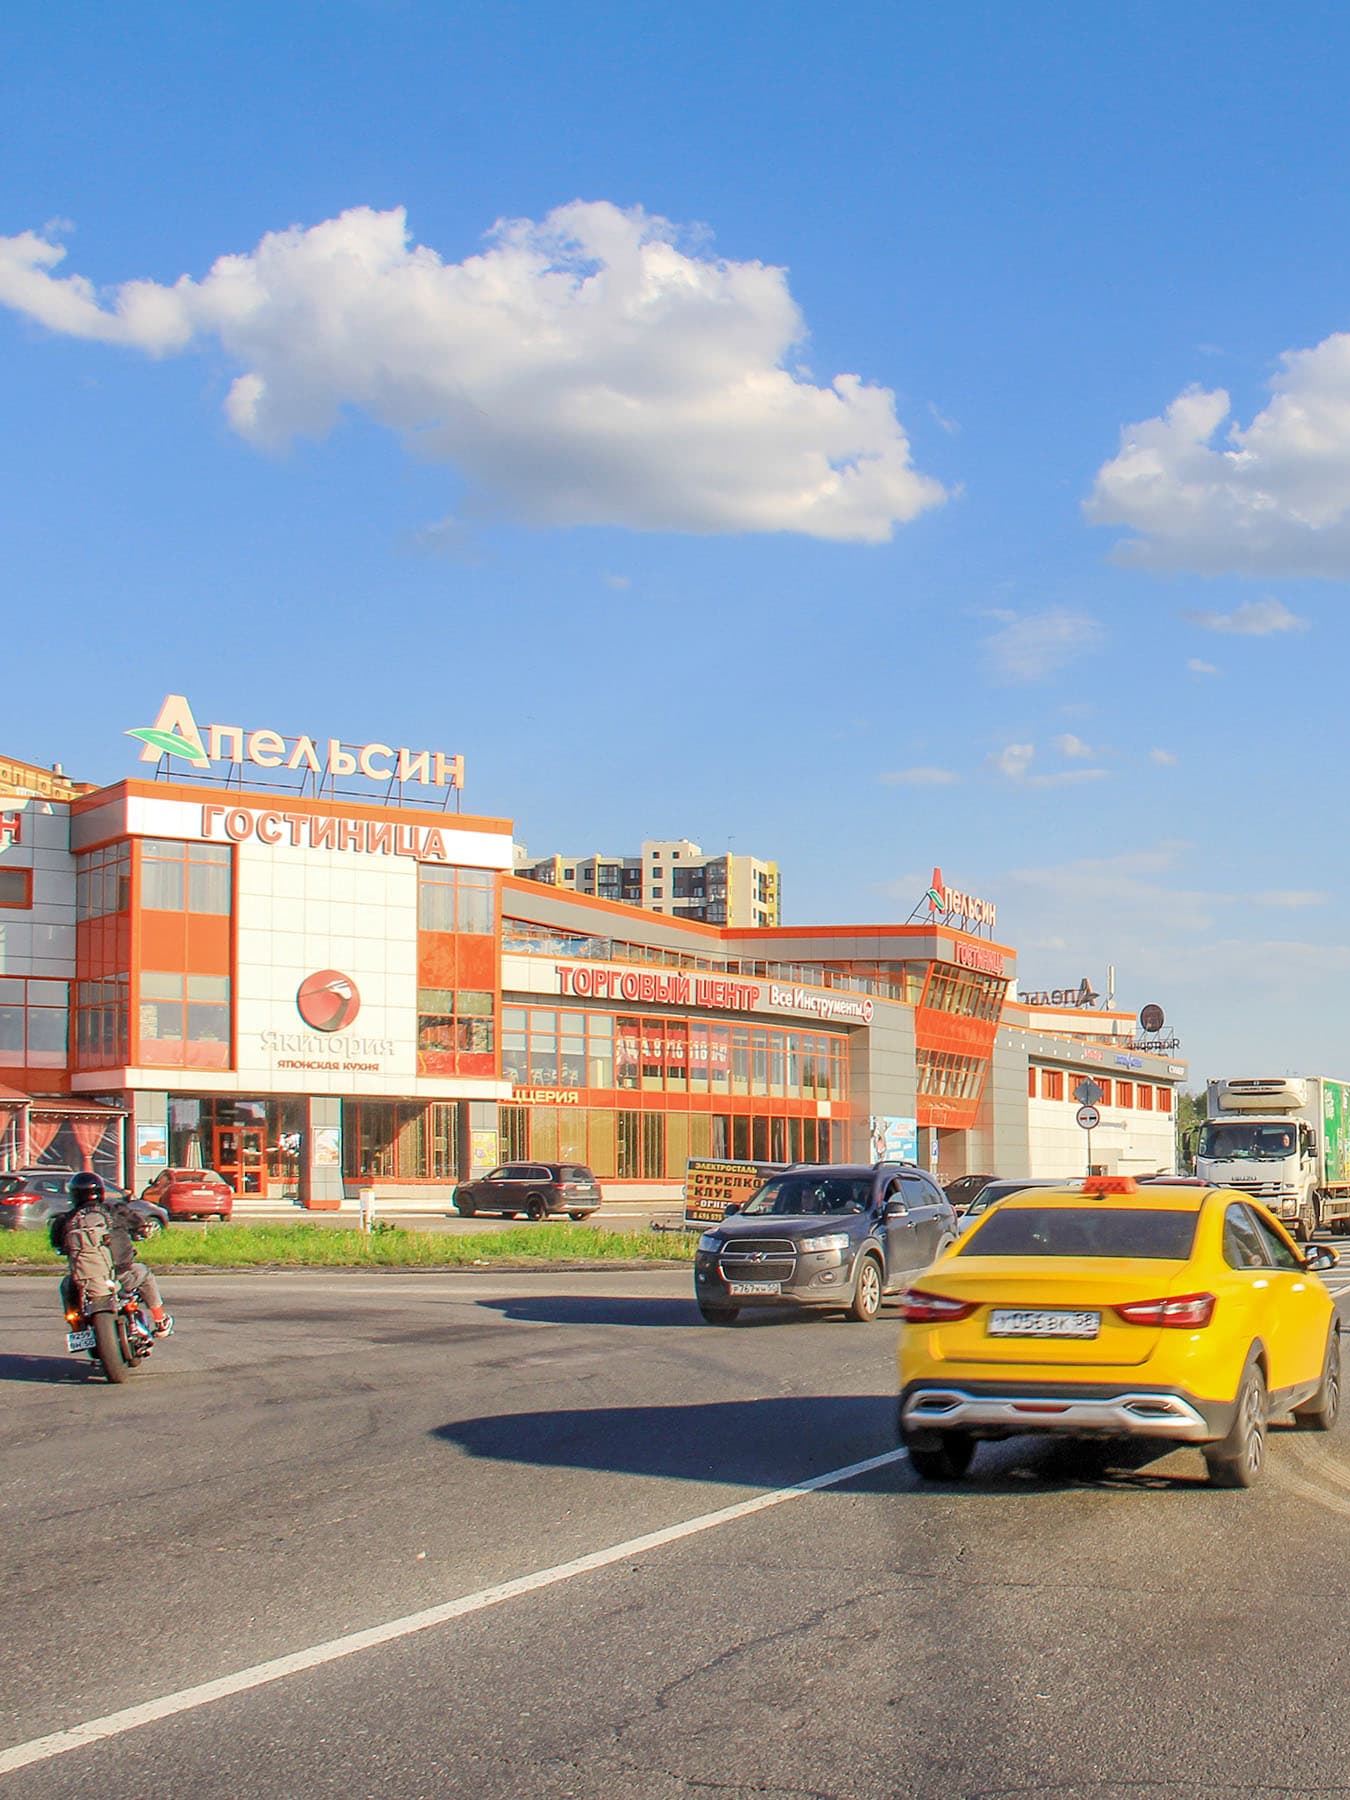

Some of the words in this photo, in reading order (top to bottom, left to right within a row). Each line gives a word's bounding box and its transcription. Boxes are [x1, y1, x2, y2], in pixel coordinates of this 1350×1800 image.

[140, 694, 465, 789] Апельсин
[202, 803, 448, 859] ГОСТИНИЦА
[929, 867, 996, 928] Апельсин
[556, 966, 691, 1005] ТОРГОВЫЙ
[696, 979, 760, 1010] ЦЕНТР
[260, 1030, 396, 1059] Якитория
[277, 1060, 340, 1070] ЯПОНСКАЯ
[343, 1062, 380, 1072] КУХНЯ
[695, 1162, 758, 1174] ЭЛЕКТРОСТАЛЬ
[694, 1186, 732, 1198] КЛУБ
